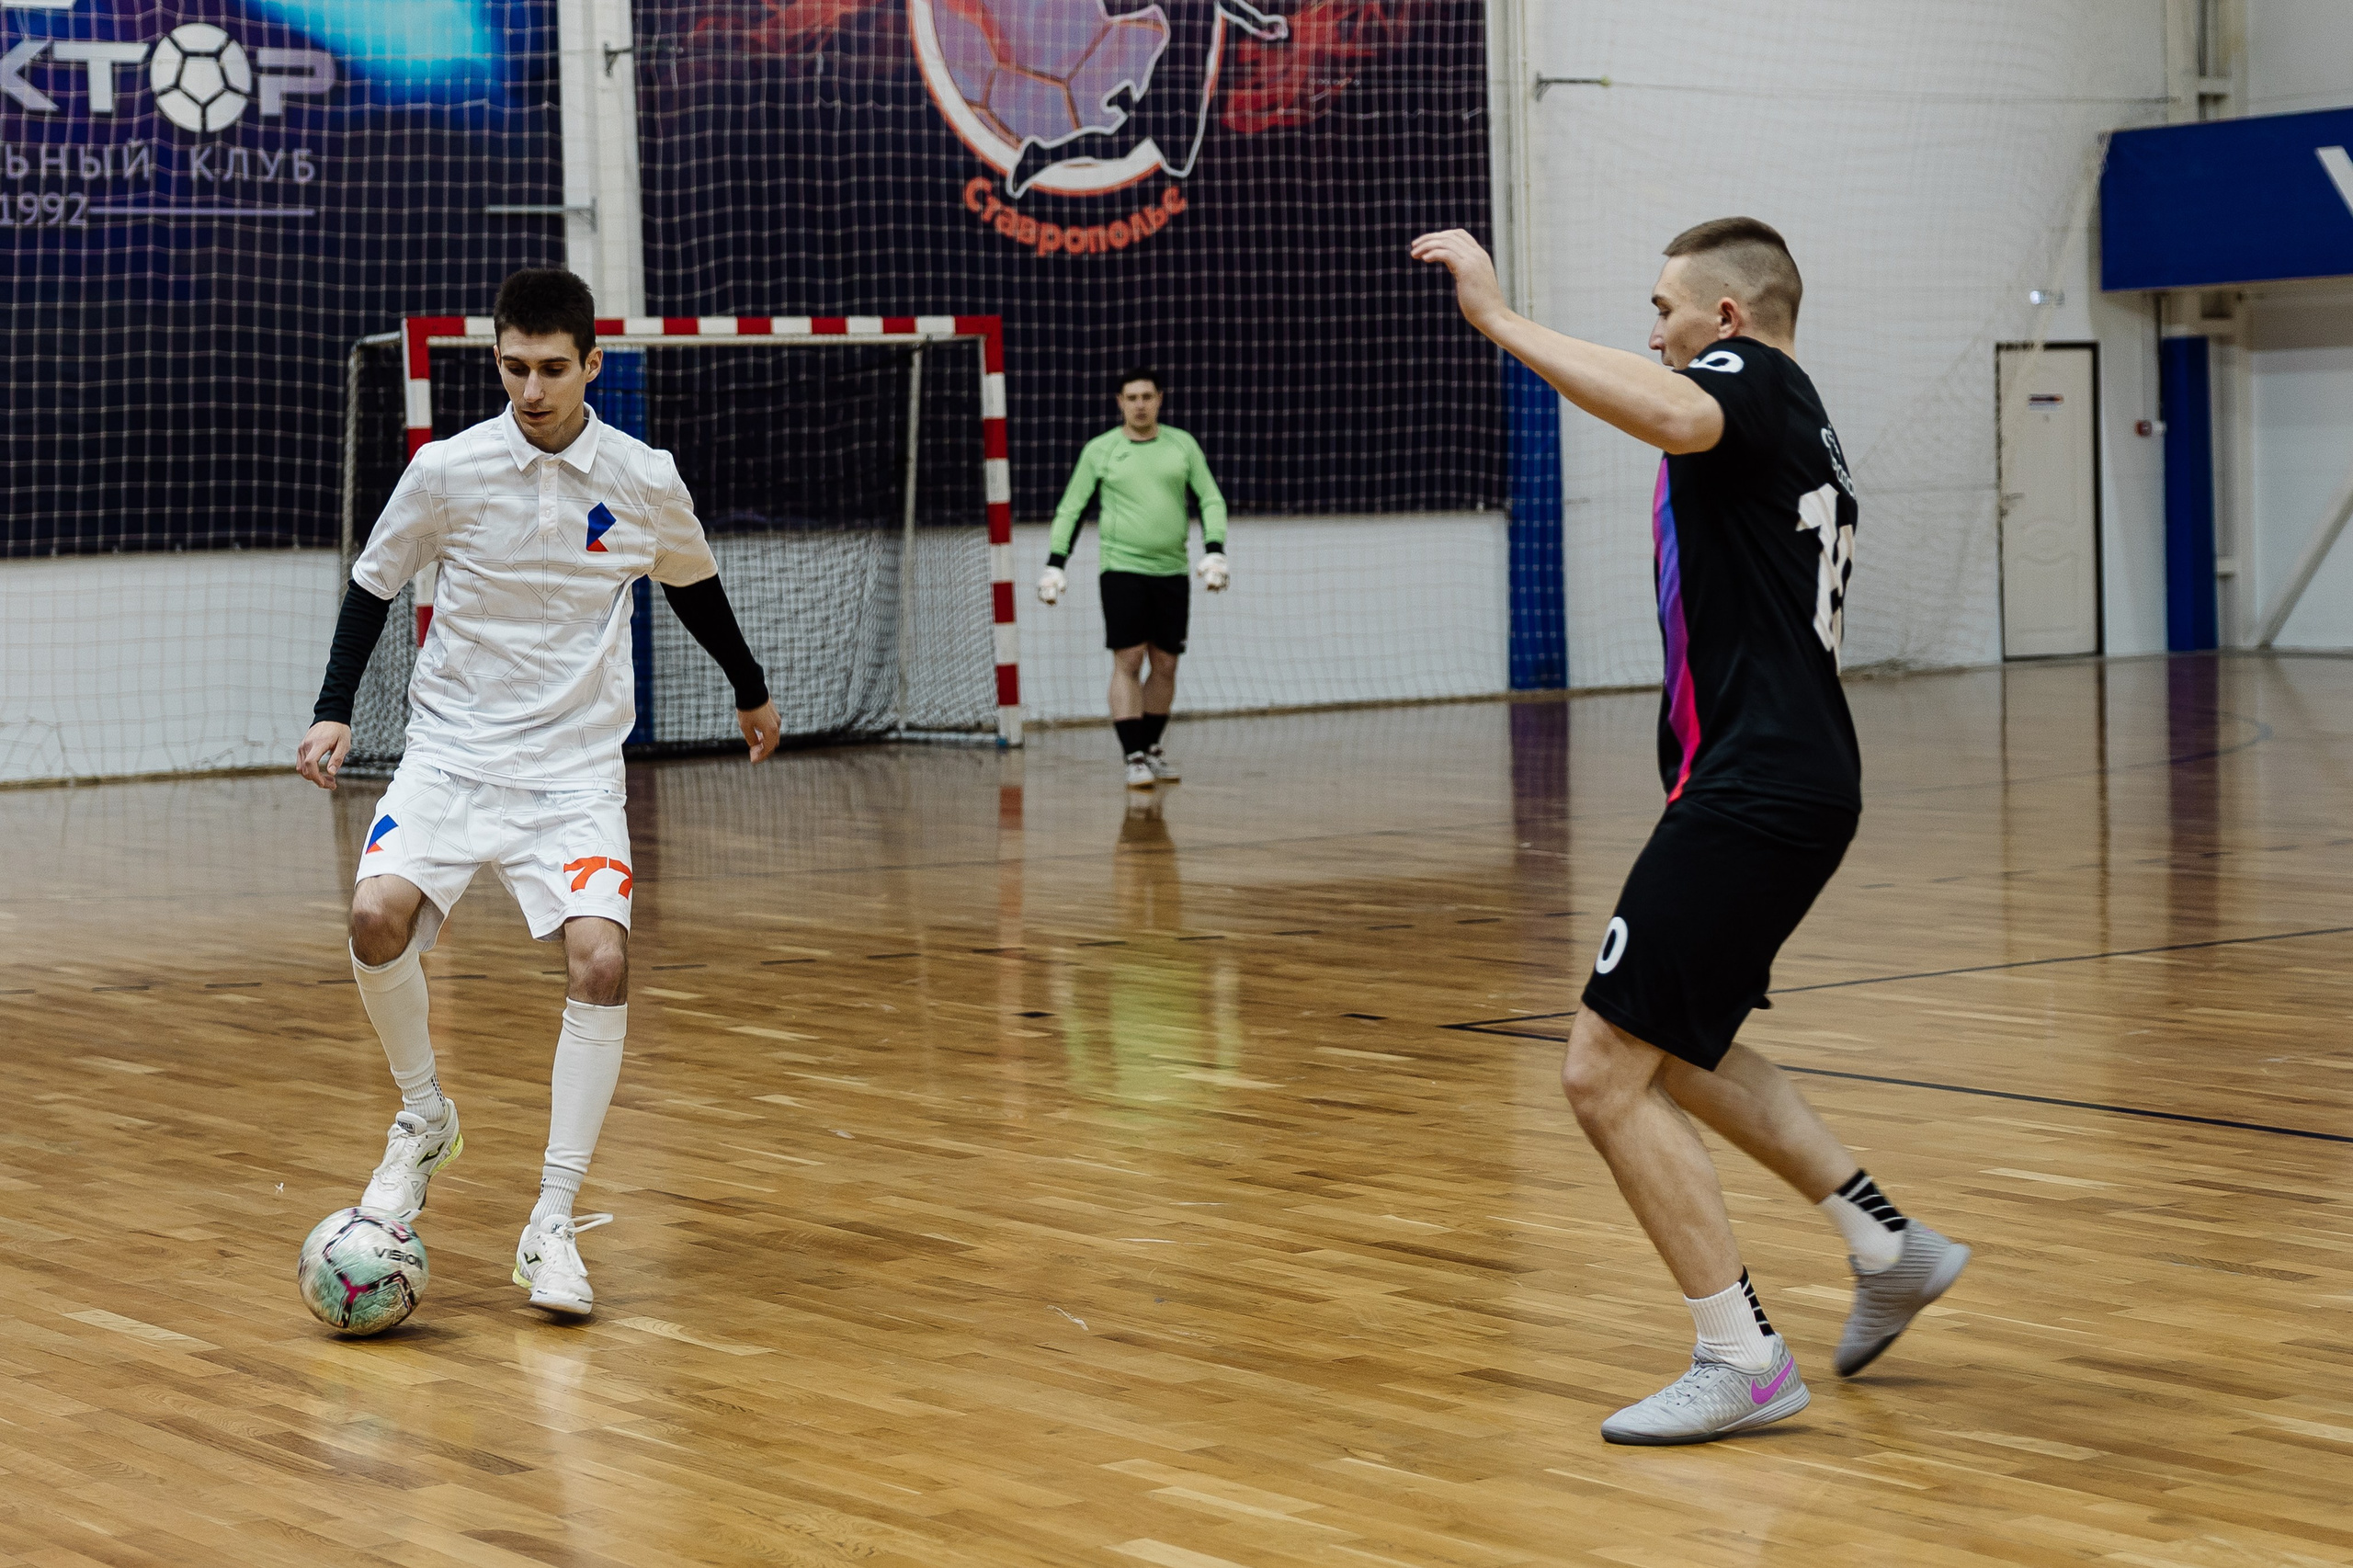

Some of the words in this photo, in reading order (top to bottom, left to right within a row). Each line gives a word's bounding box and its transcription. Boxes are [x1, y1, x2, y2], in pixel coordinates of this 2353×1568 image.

[189, 147, 315, 183] КЛУБ
[0, 192, 87, 226] 1992
[963, 176, 1188, 256] Ставрополье
